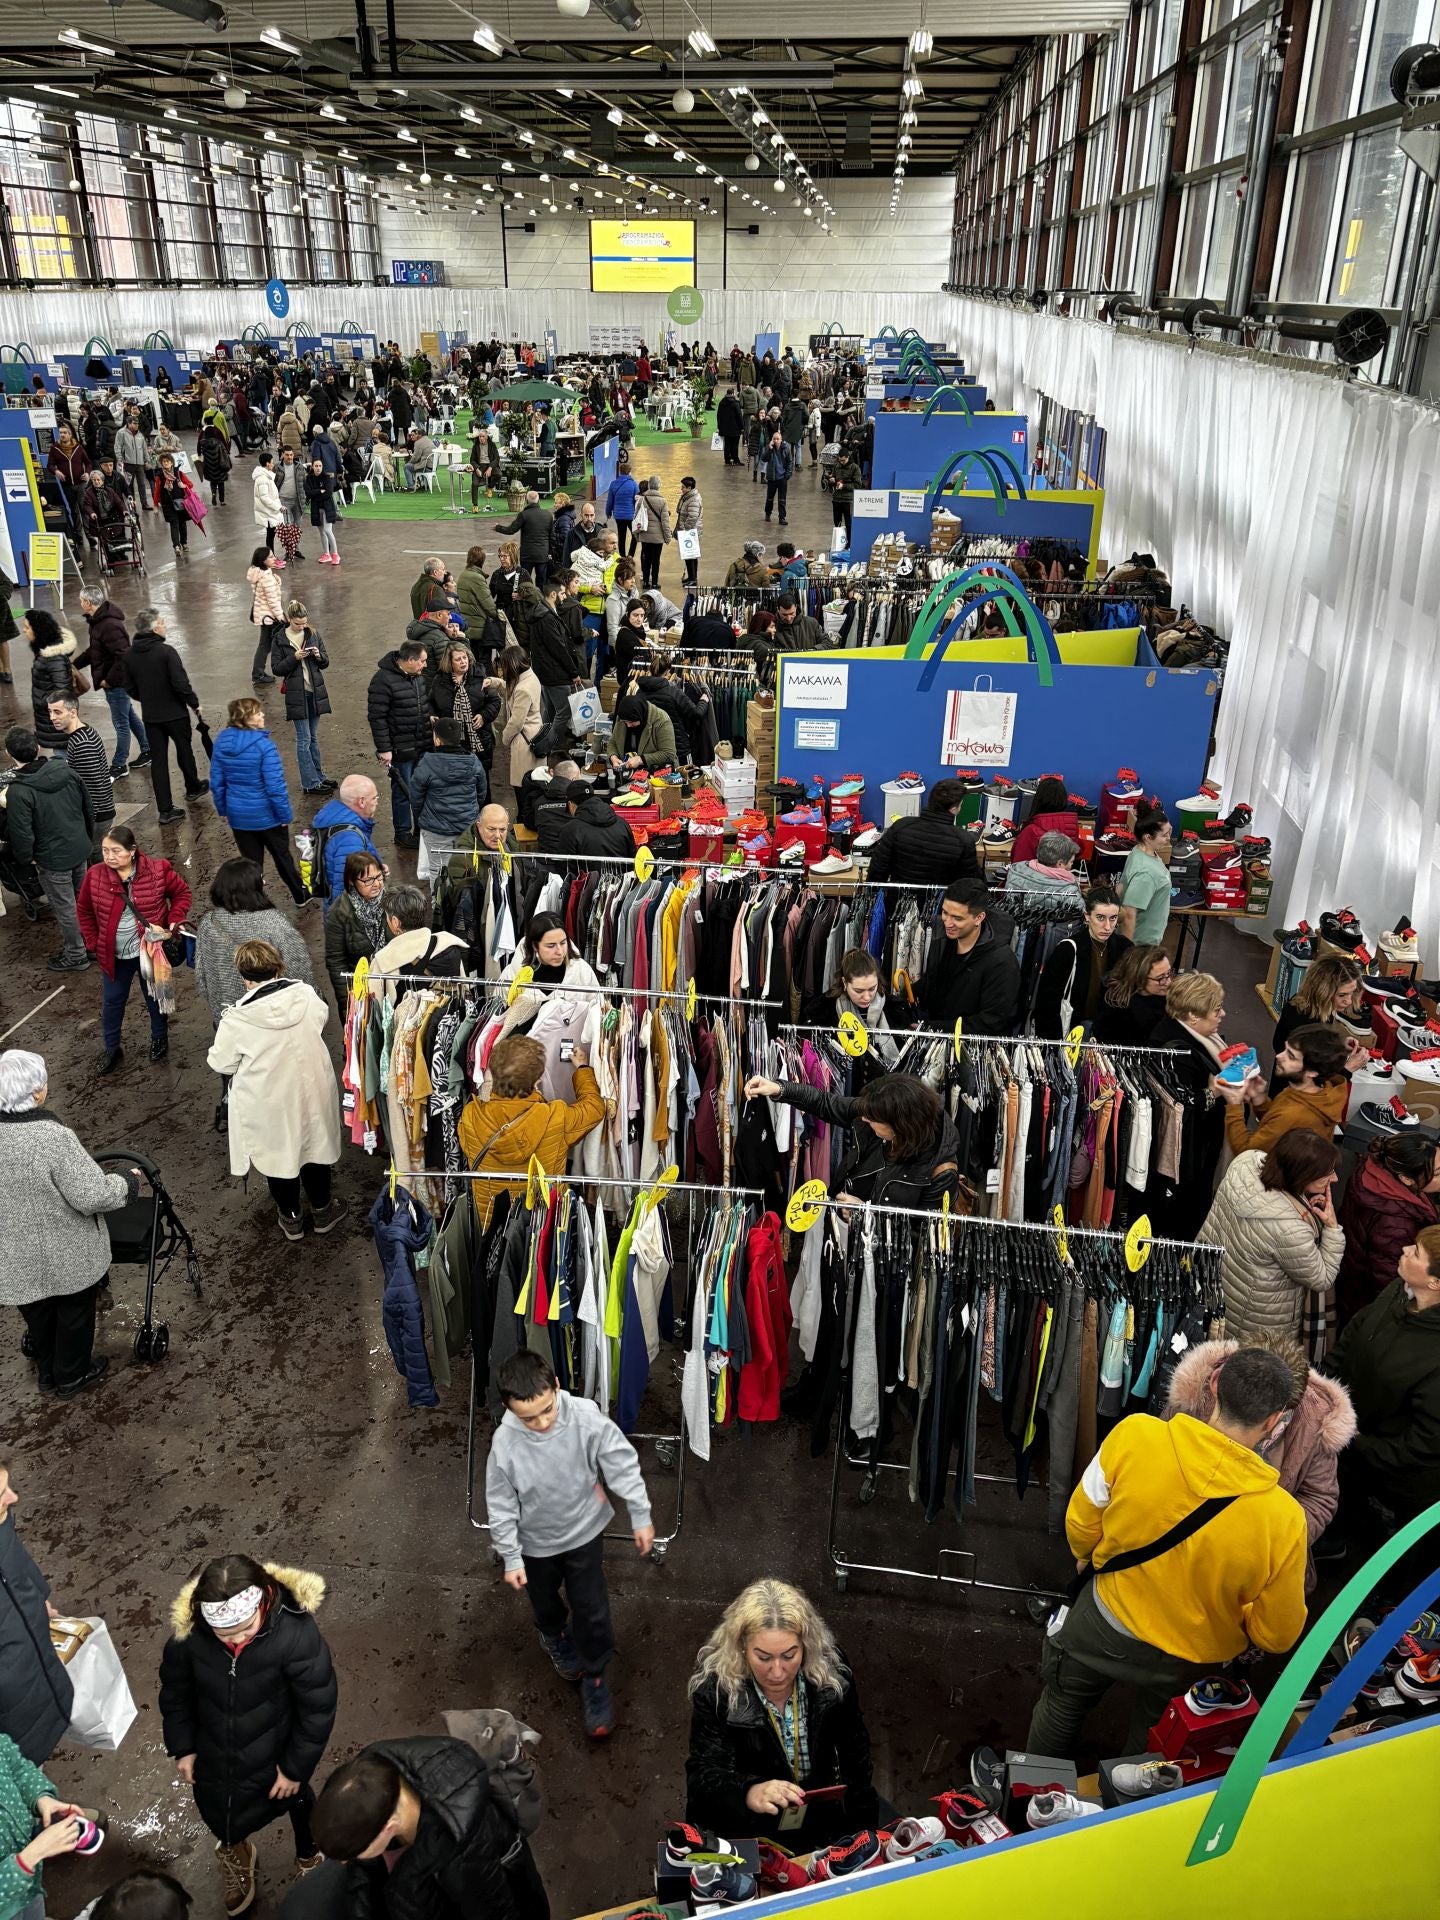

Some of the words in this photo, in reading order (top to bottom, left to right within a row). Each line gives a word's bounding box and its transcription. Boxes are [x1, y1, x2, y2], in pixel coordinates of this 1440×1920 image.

[394, 262, 407, 281] 02
[788, 675, 843, 686] MAKAWA
[946, 737, 1005, 756] makawa
[852, 1020, 859, 1032] S
[853, 1040, 863, 1053] S
[1415, 1034, 1429, 1048] N
[1379, 1111, 1391, 1125] N
[713, 1889, 728, 1899] N
